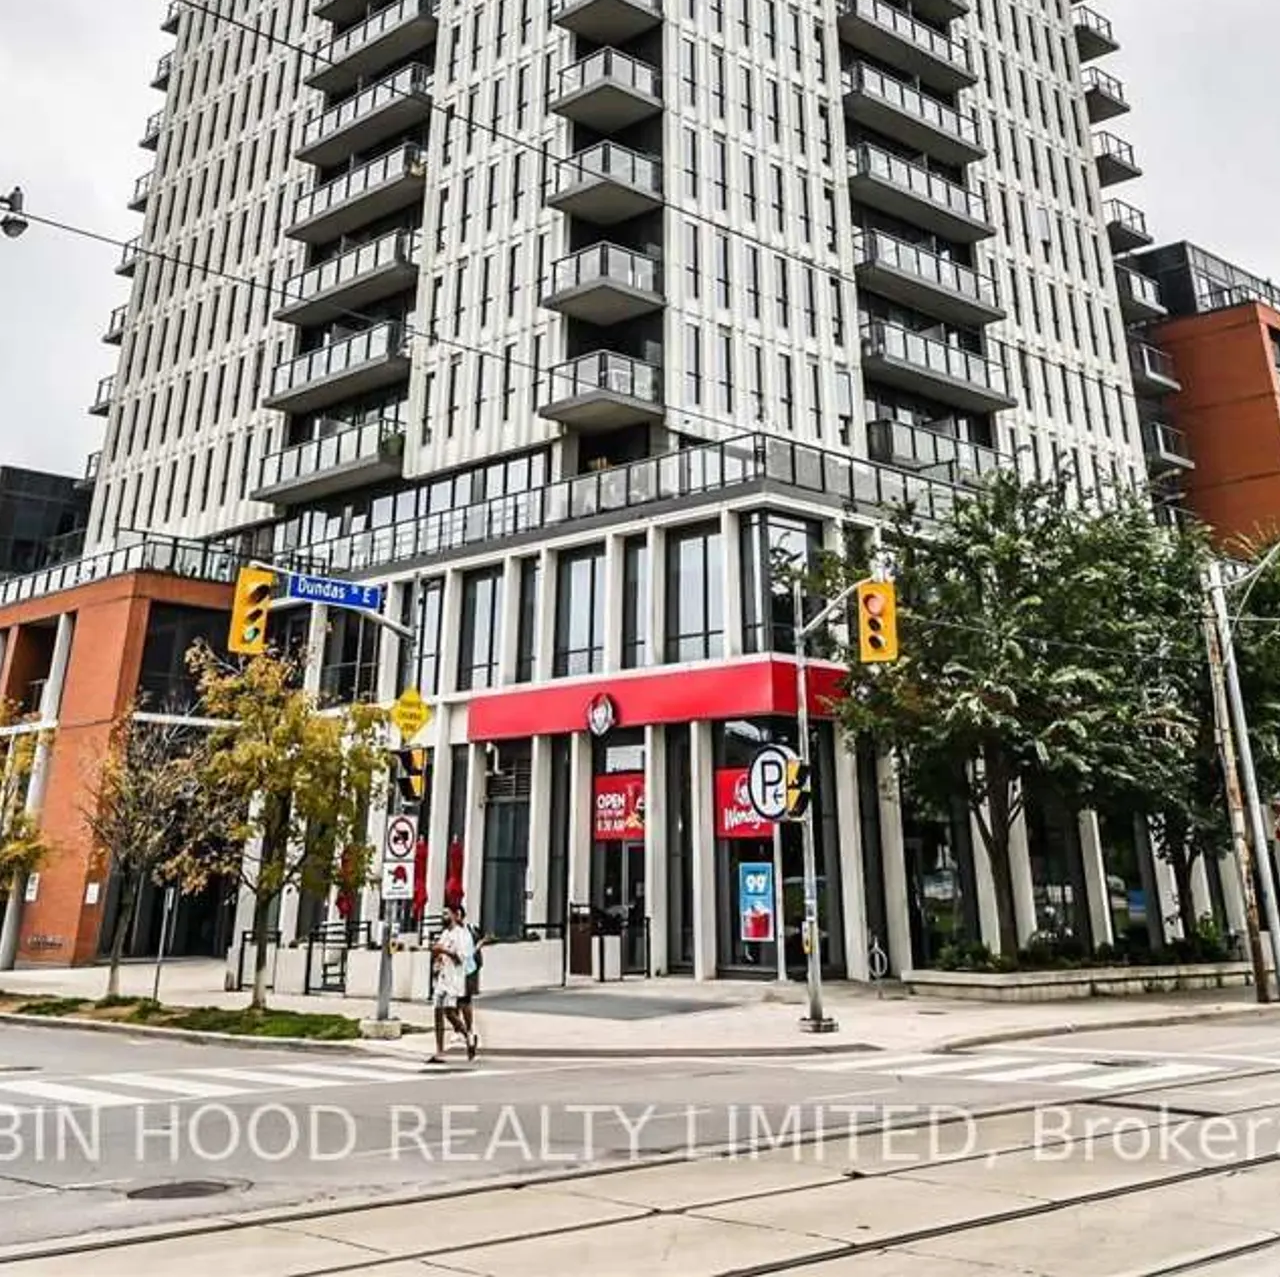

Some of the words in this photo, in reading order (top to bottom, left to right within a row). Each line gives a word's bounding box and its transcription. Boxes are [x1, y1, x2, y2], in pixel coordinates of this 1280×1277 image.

[298, 577, 346, 599] Dundas
[363, 588, 371, 603] E
[761, 761, 783, 805] P
[597, 793, 625, 810] OPEN
